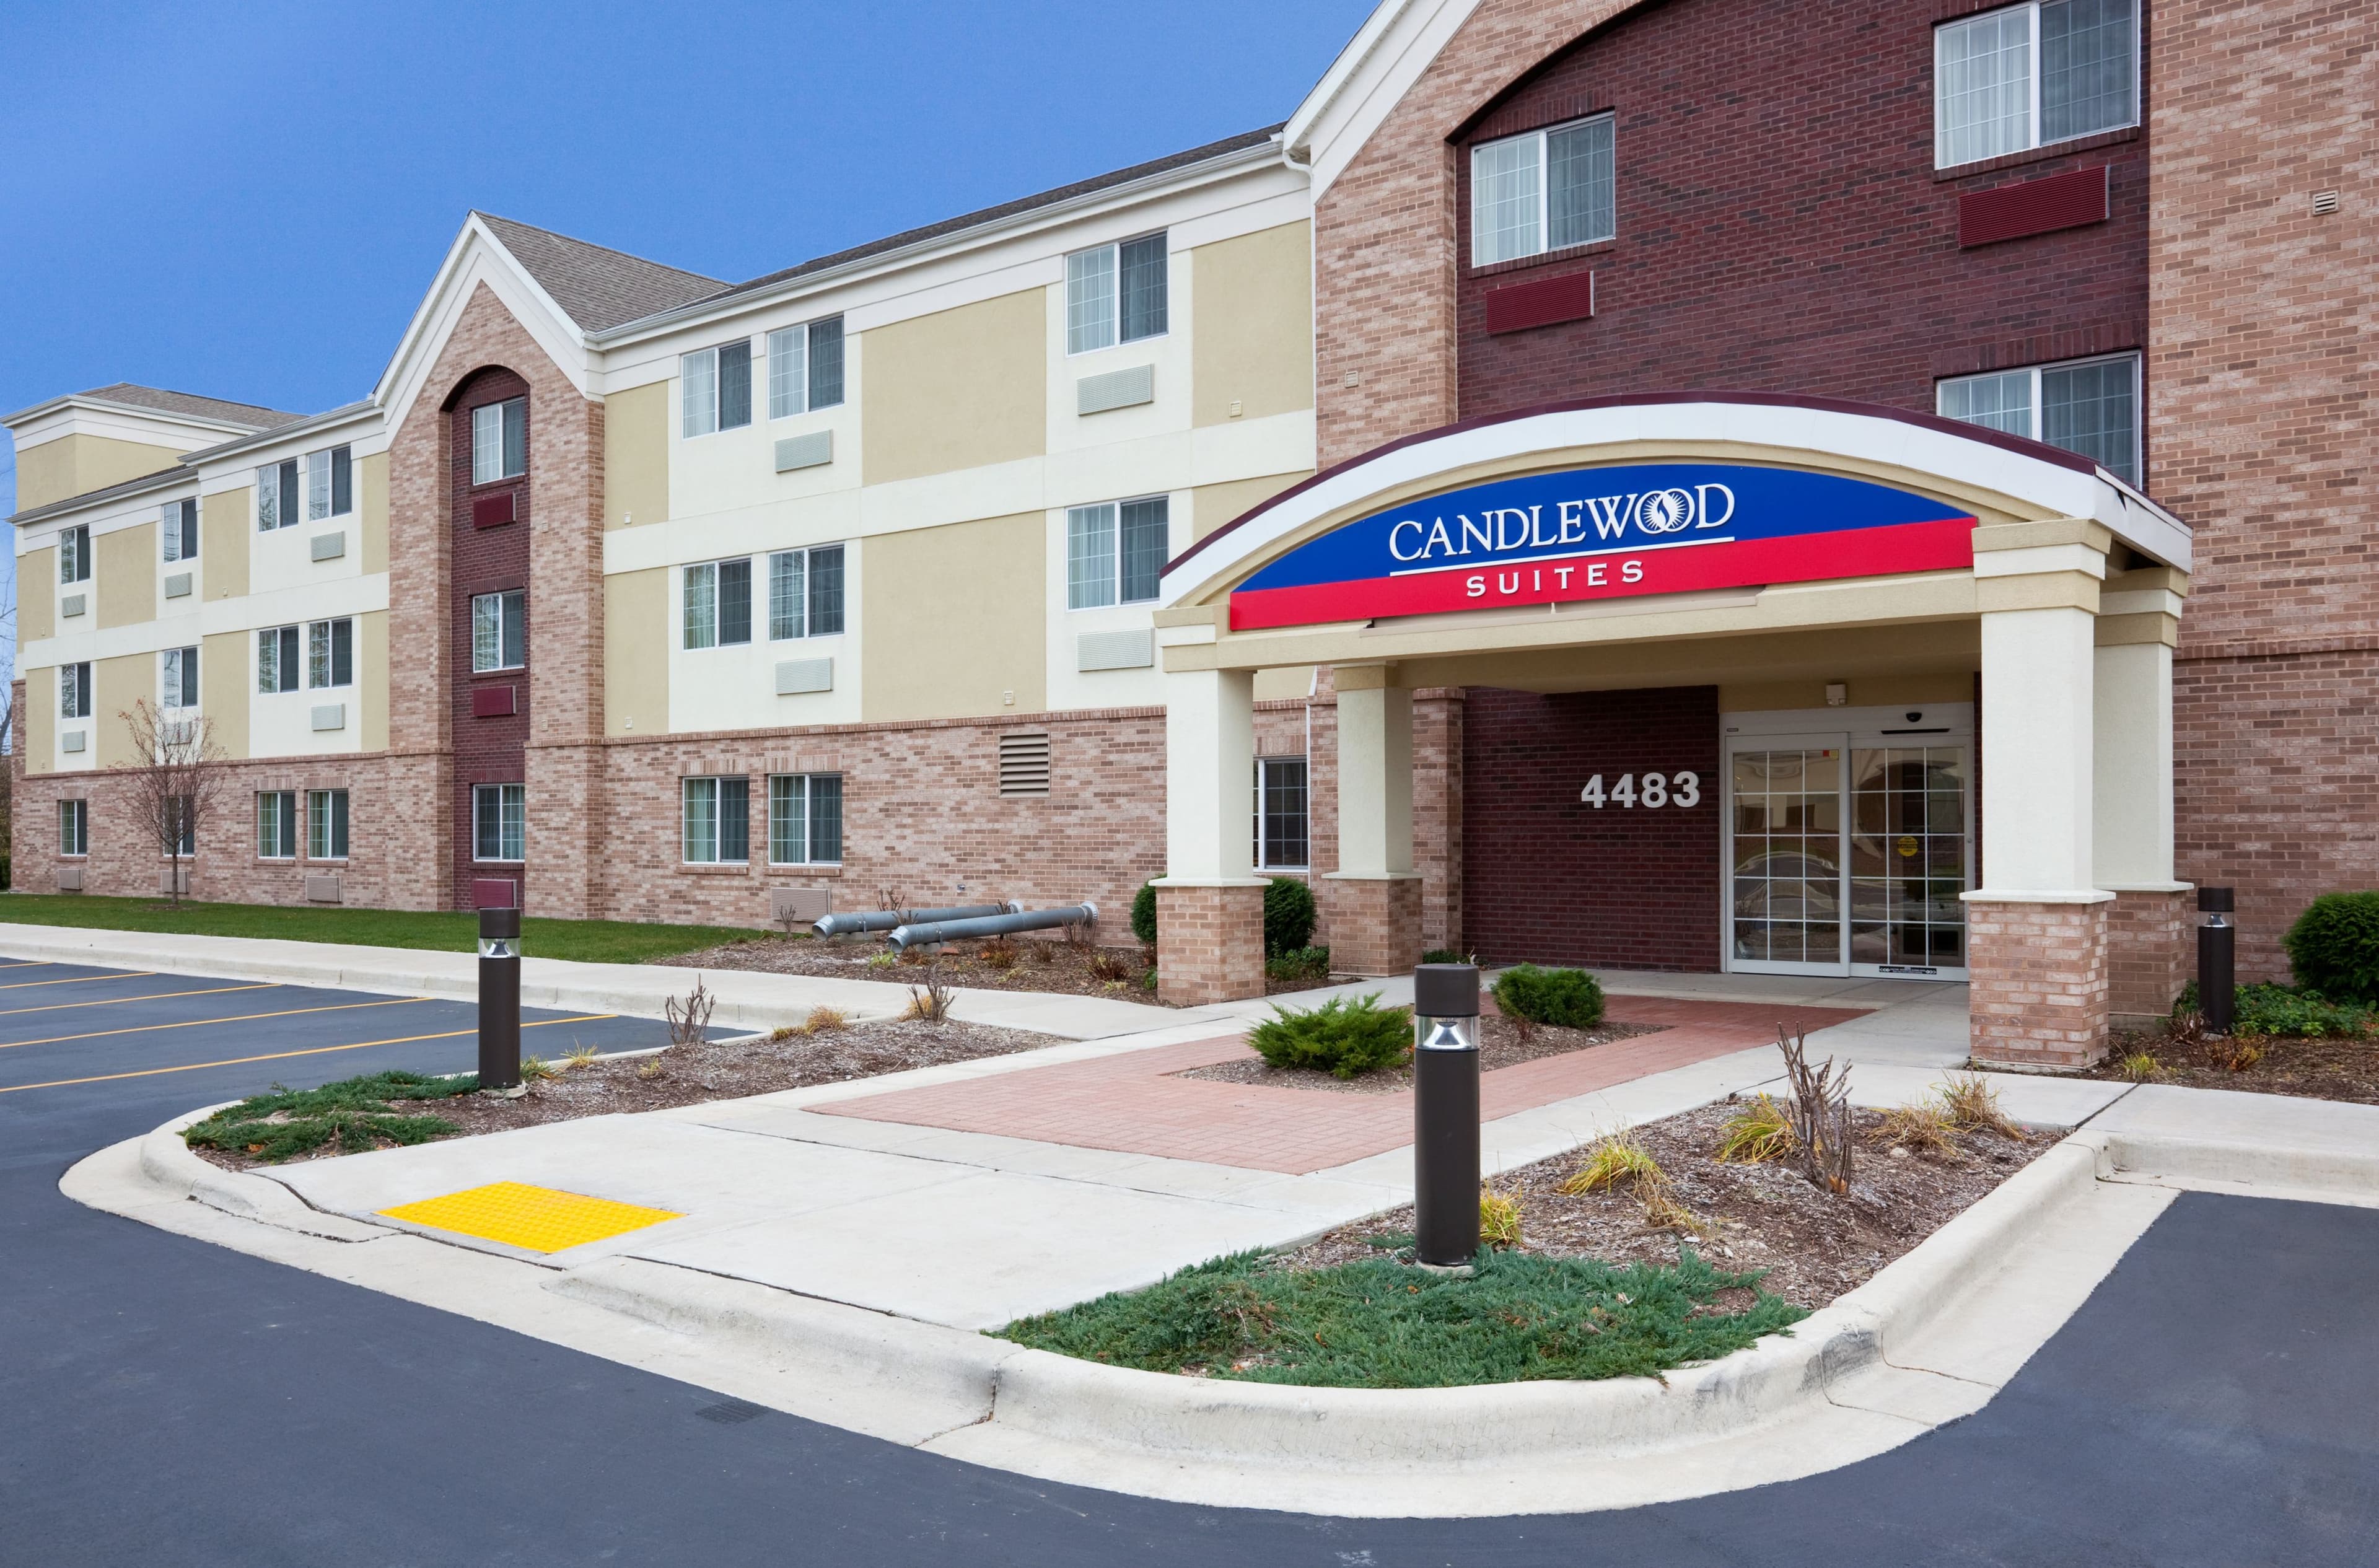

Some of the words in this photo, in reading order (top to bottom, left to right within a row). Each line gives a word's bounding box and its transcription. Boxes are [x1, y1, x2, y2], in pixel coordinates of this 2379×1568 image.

[1389, 483, 1735, 561] CANDLEWOOD
[1466, 561, 1644, 597] SUITES
[1581, 771, 1700, 808] 4483
